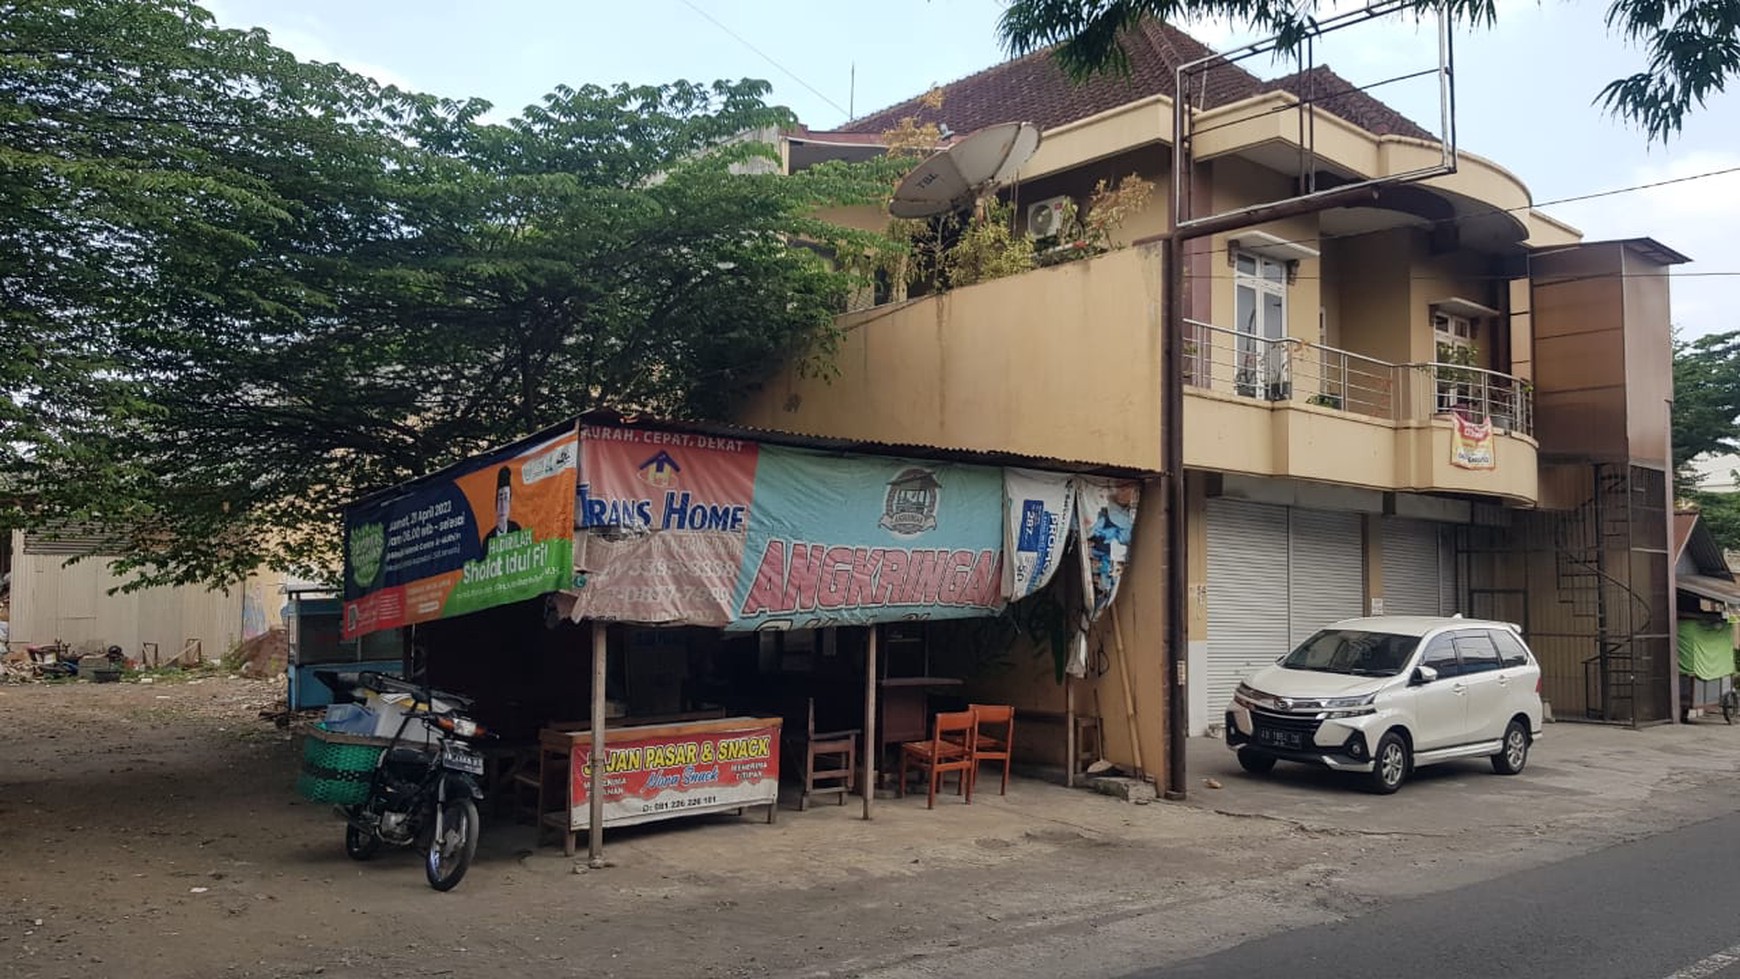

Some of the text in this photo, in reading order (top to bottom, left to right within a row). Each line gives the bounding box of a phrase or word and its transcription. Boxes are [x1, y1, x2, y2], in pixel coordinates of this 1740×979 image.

[698, 436, 744, 452] DEKAT
[661, 490, 746, 532] HOME
[505, 547, 531, 575] Idul
[582, 735, 772, 778] JJAN PASAR & SNACK
[682, 765, 719, 787] Snack
